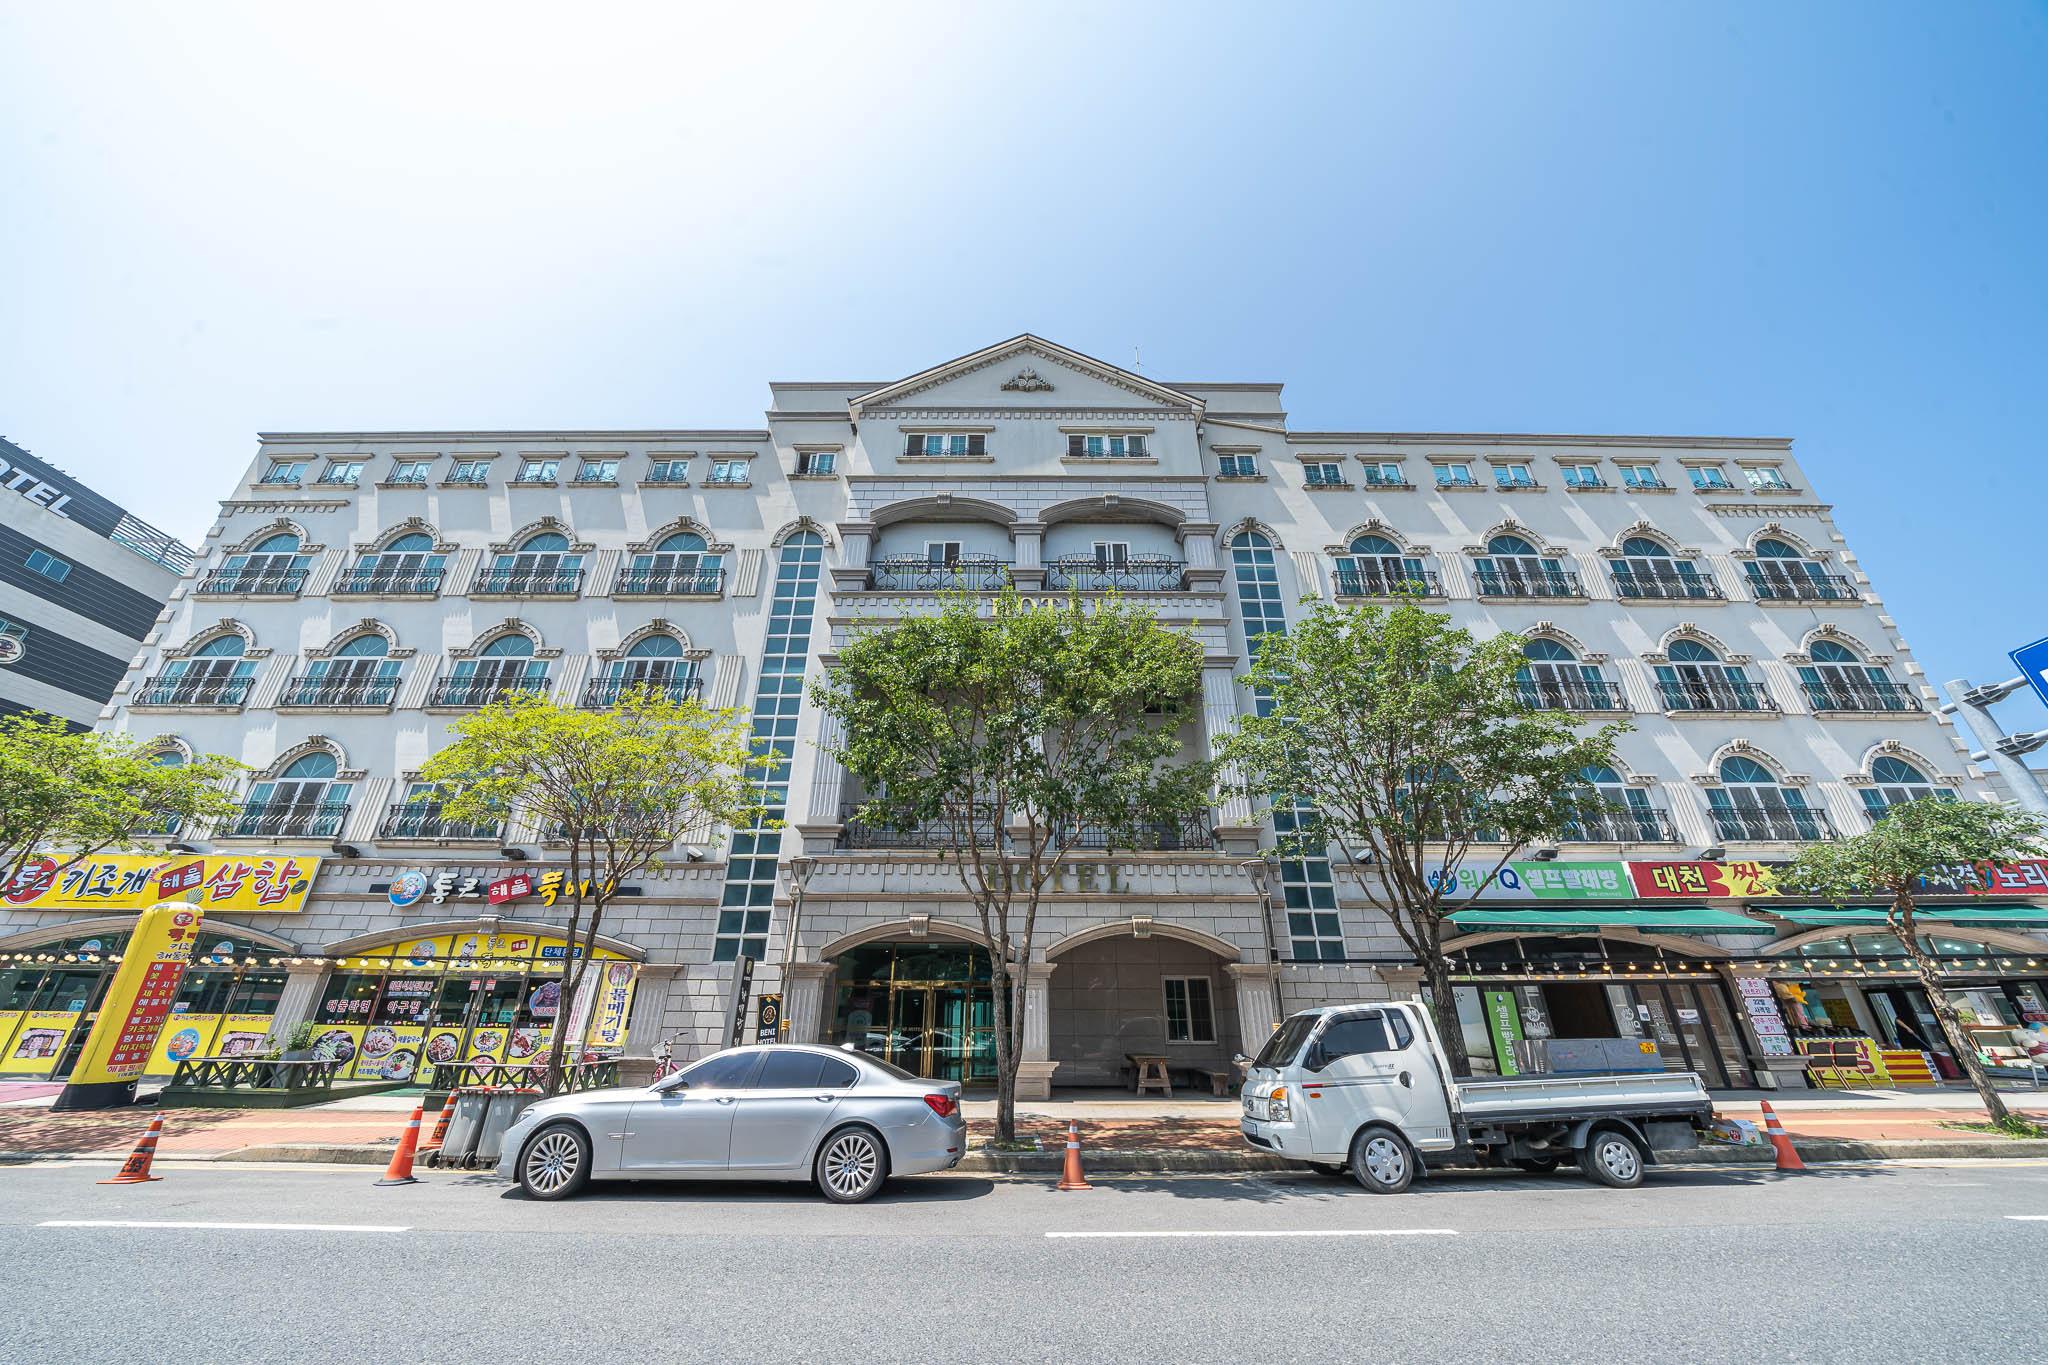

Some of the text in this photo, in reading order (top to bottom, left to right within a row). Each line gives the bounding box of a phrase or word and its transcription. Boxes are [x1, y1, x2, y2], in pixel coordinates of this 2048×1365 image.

[61, 864, 152, 898] 키조개
[161, 867, 201, 889] 해물
[204, 859, 303, 906] 삼합
[490, 879, 528, 896] 해물
[1525, 869, 1619, 889] 셀프빨래방
[1652, 865, 1709, 893] 대천
[602, 988, 629, 1043] 물메기탕
[760, 1028, 776, 1037] BENI
